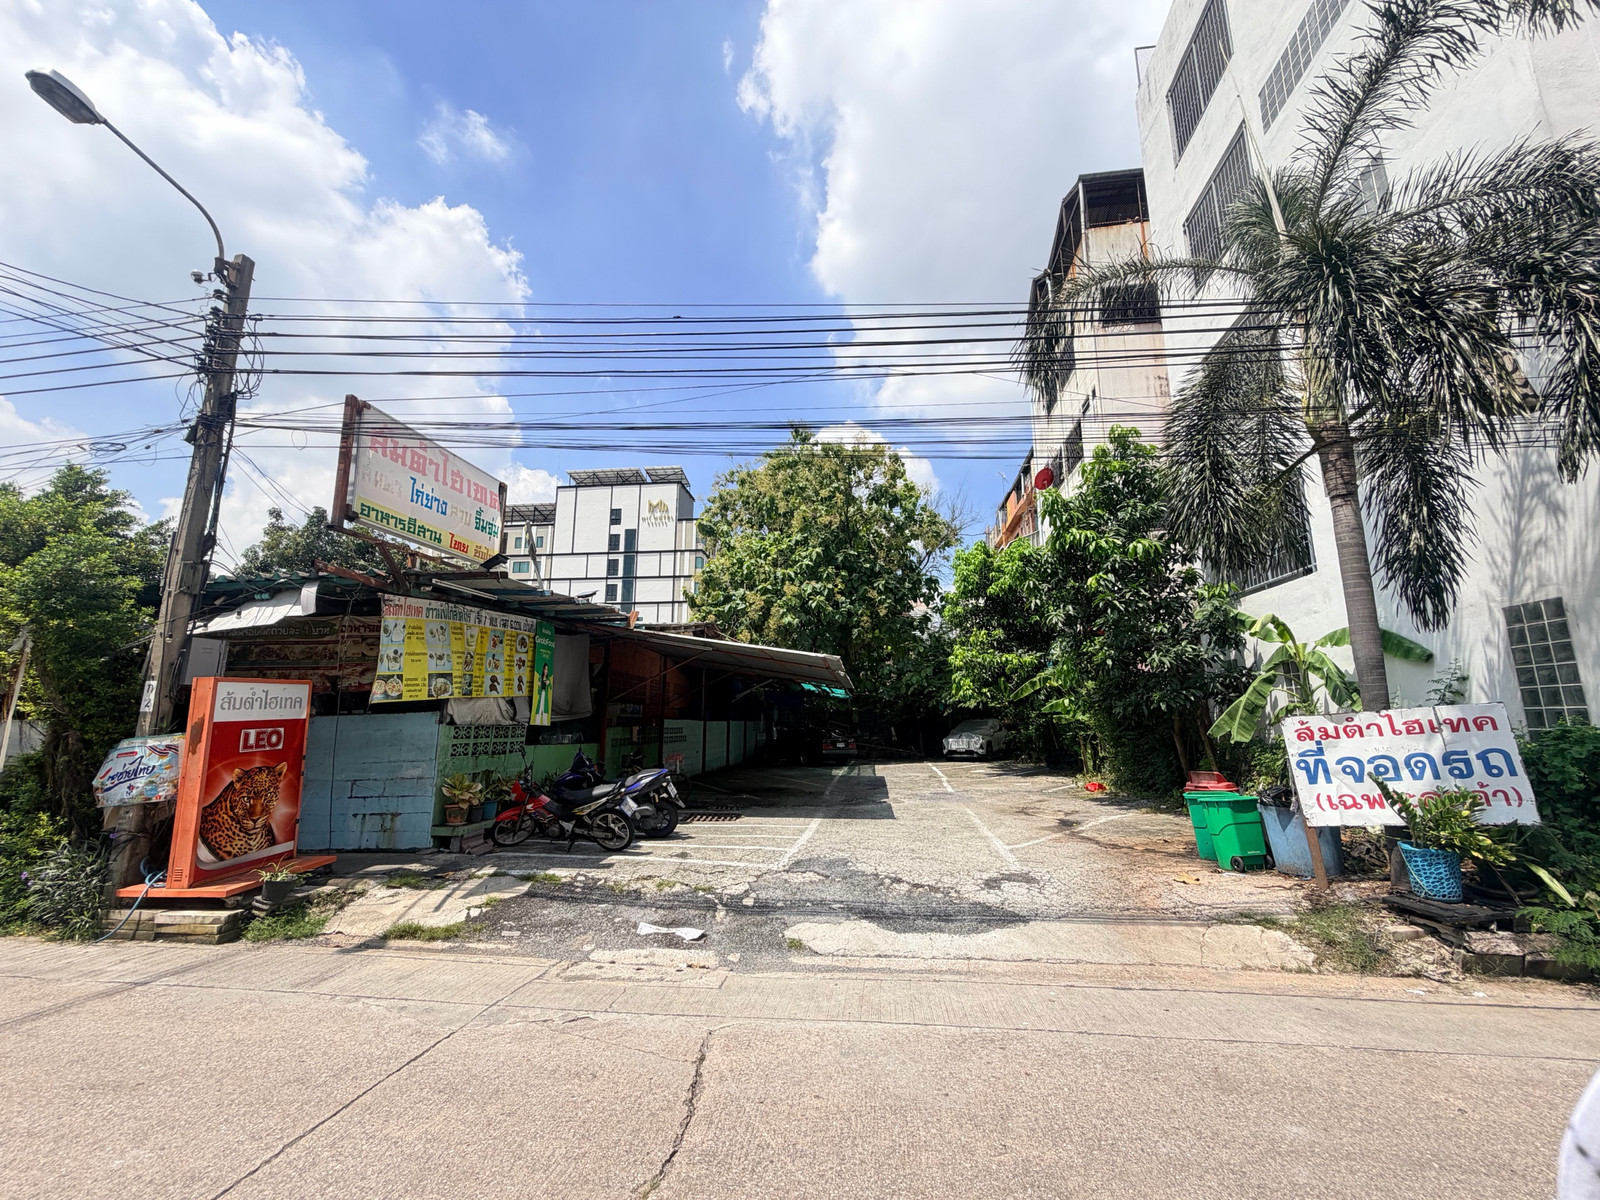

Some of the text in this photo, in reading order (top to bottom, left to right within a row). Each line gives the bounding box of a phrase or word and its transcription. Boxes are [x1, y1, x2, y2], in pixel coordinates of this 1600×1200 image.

[409, 476, 448, 516] ไก่ย่าง
[360, 502, 442, 544] อาหารอีสาน
[448, 532, 469, 554] ไทย
[219, 689, 303, 711] ส้มตำไฮเทค
[242, 729, 283, 750] LEO
[1293, 713, 1499, 742] ส้มตำไฮเทค
[1295, 740, 1518, 785] ที่จอดรถ
